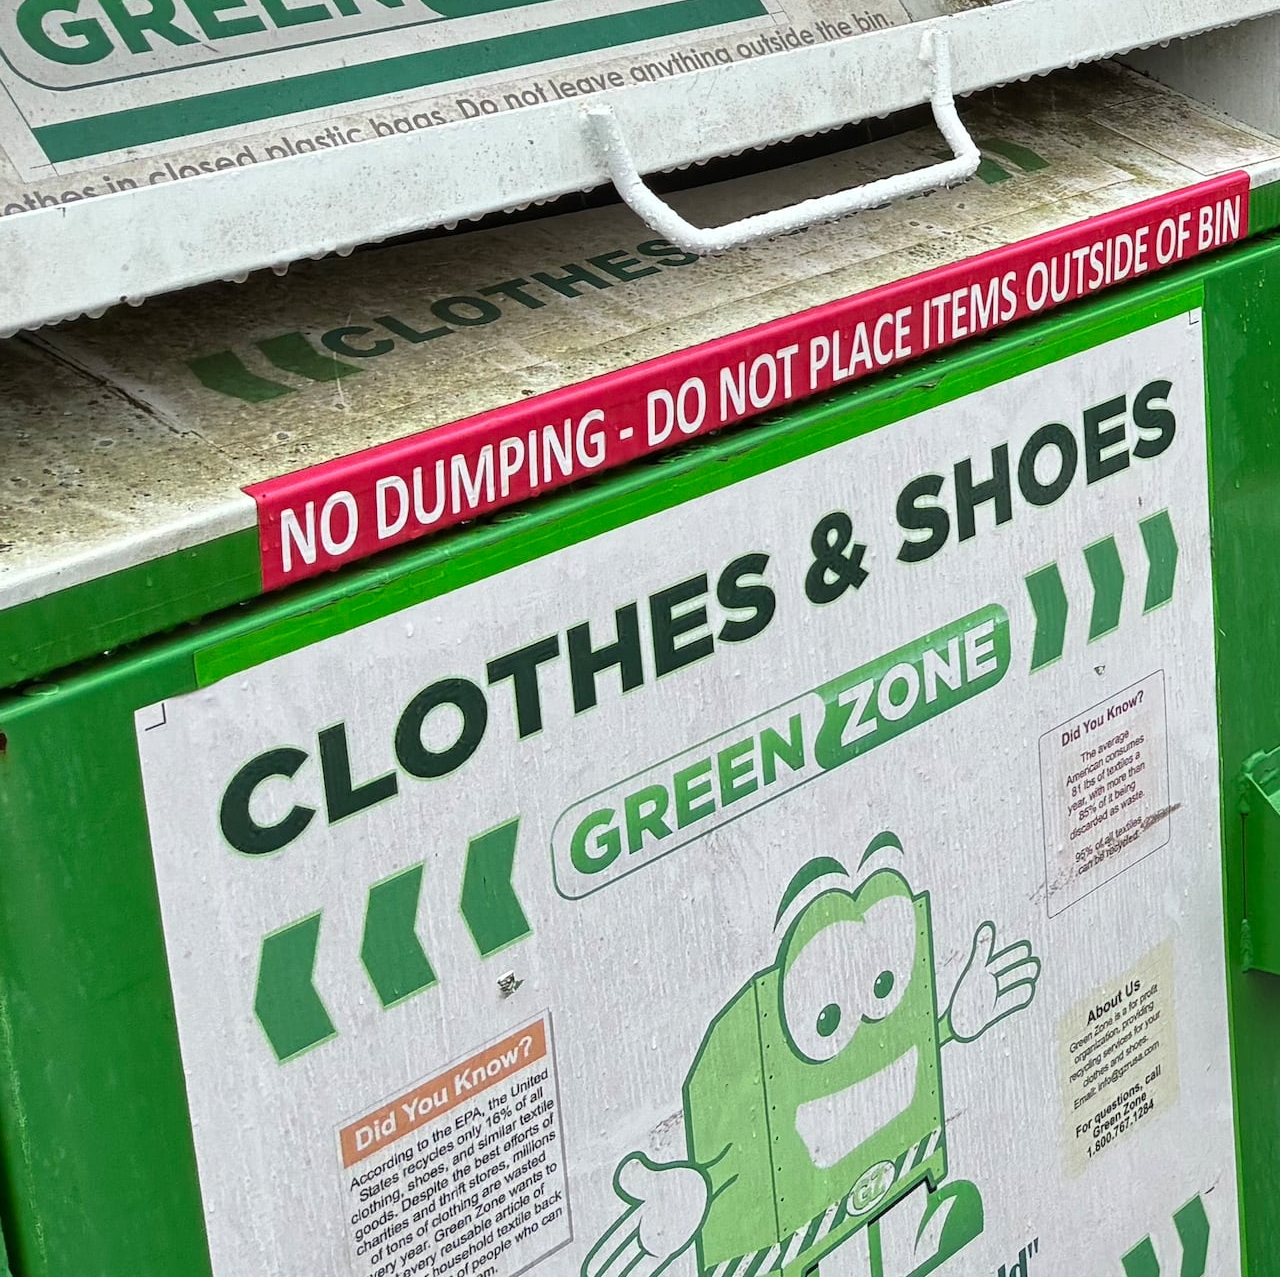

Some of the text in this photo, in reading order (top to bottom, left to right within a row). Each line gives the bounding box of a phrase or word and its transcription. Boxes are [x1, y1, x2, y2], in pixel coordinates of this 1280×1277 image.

[104, 175, 139, 194] in
[150, 146, 258, 184] closed
[265, 124, 361, 161] plastic
[458, 98, 499, 120] Do
[503, 85, 549, 110] not
[551, 71, 625, 99] leave
[630, 46, 733, 83] anything
[737, 22, 814, 58] outside
[816, 12, 852, 40] the
[855, 7, 895, 32] bin.
[321, 239, 700, 359] CLOTHES
[280, 195, 1242, 573] NO DUMPING DO NOT PLACE ITEMS OUTSIDE OF BIN
[221, 380, 1177, 857] CLOTHES & SHOES
[569, 622, 998, 875] GREEN ZONE
[1061, 689, 1144, 747] Did You Know?
[1086, 979, 1141, 1027] About Us
[350, 1067, 549, 1192] According to the EPA, the United
[355, 1035, 533, 1152] Did You Know?
[359, 1086, 543, 1203] States recycles only 16% of all
[1075, 1118, 1093, 1139] For
[1094, 1083, 1143, 1124] questions,
[1087, 1098, 1154, 1159] 1.800.767.1284
[1092, 1091, 1147, 1139] Green Zone
[351, 1099, 554, 1225] clothing, shoes, and similar textile
[355, 1111, 554, 1243] goods. Despite the best efforts of
[356, 1130, 556, 1256] charities and thrift stores, millions
[370, 1149, 546, 1265] of tons of clothing are wasted
[399, 1240, 431, 1268] year.
[434, 1214, 472, 1243] Green
[474, 1193, 506, 1219] Zone
[508, 1170, 543, 1198] wants
[545, 1162, 558, 1176] to
[402, 1252, 437, 1277] every
[440, 1218, 492, 1258] reusable
[495, 1195, 530, 1223] article
[533, 1182, 545, 1199] of
[431, 1230, 494, 1277] household
[496, 1210, 532, 1238] textile
[534, 1190, 562, 1215] back
[471, 1239, 512, 1273] people
[514, 1222, 539, 1243] who
[541, 1207, 563, 1226] can
